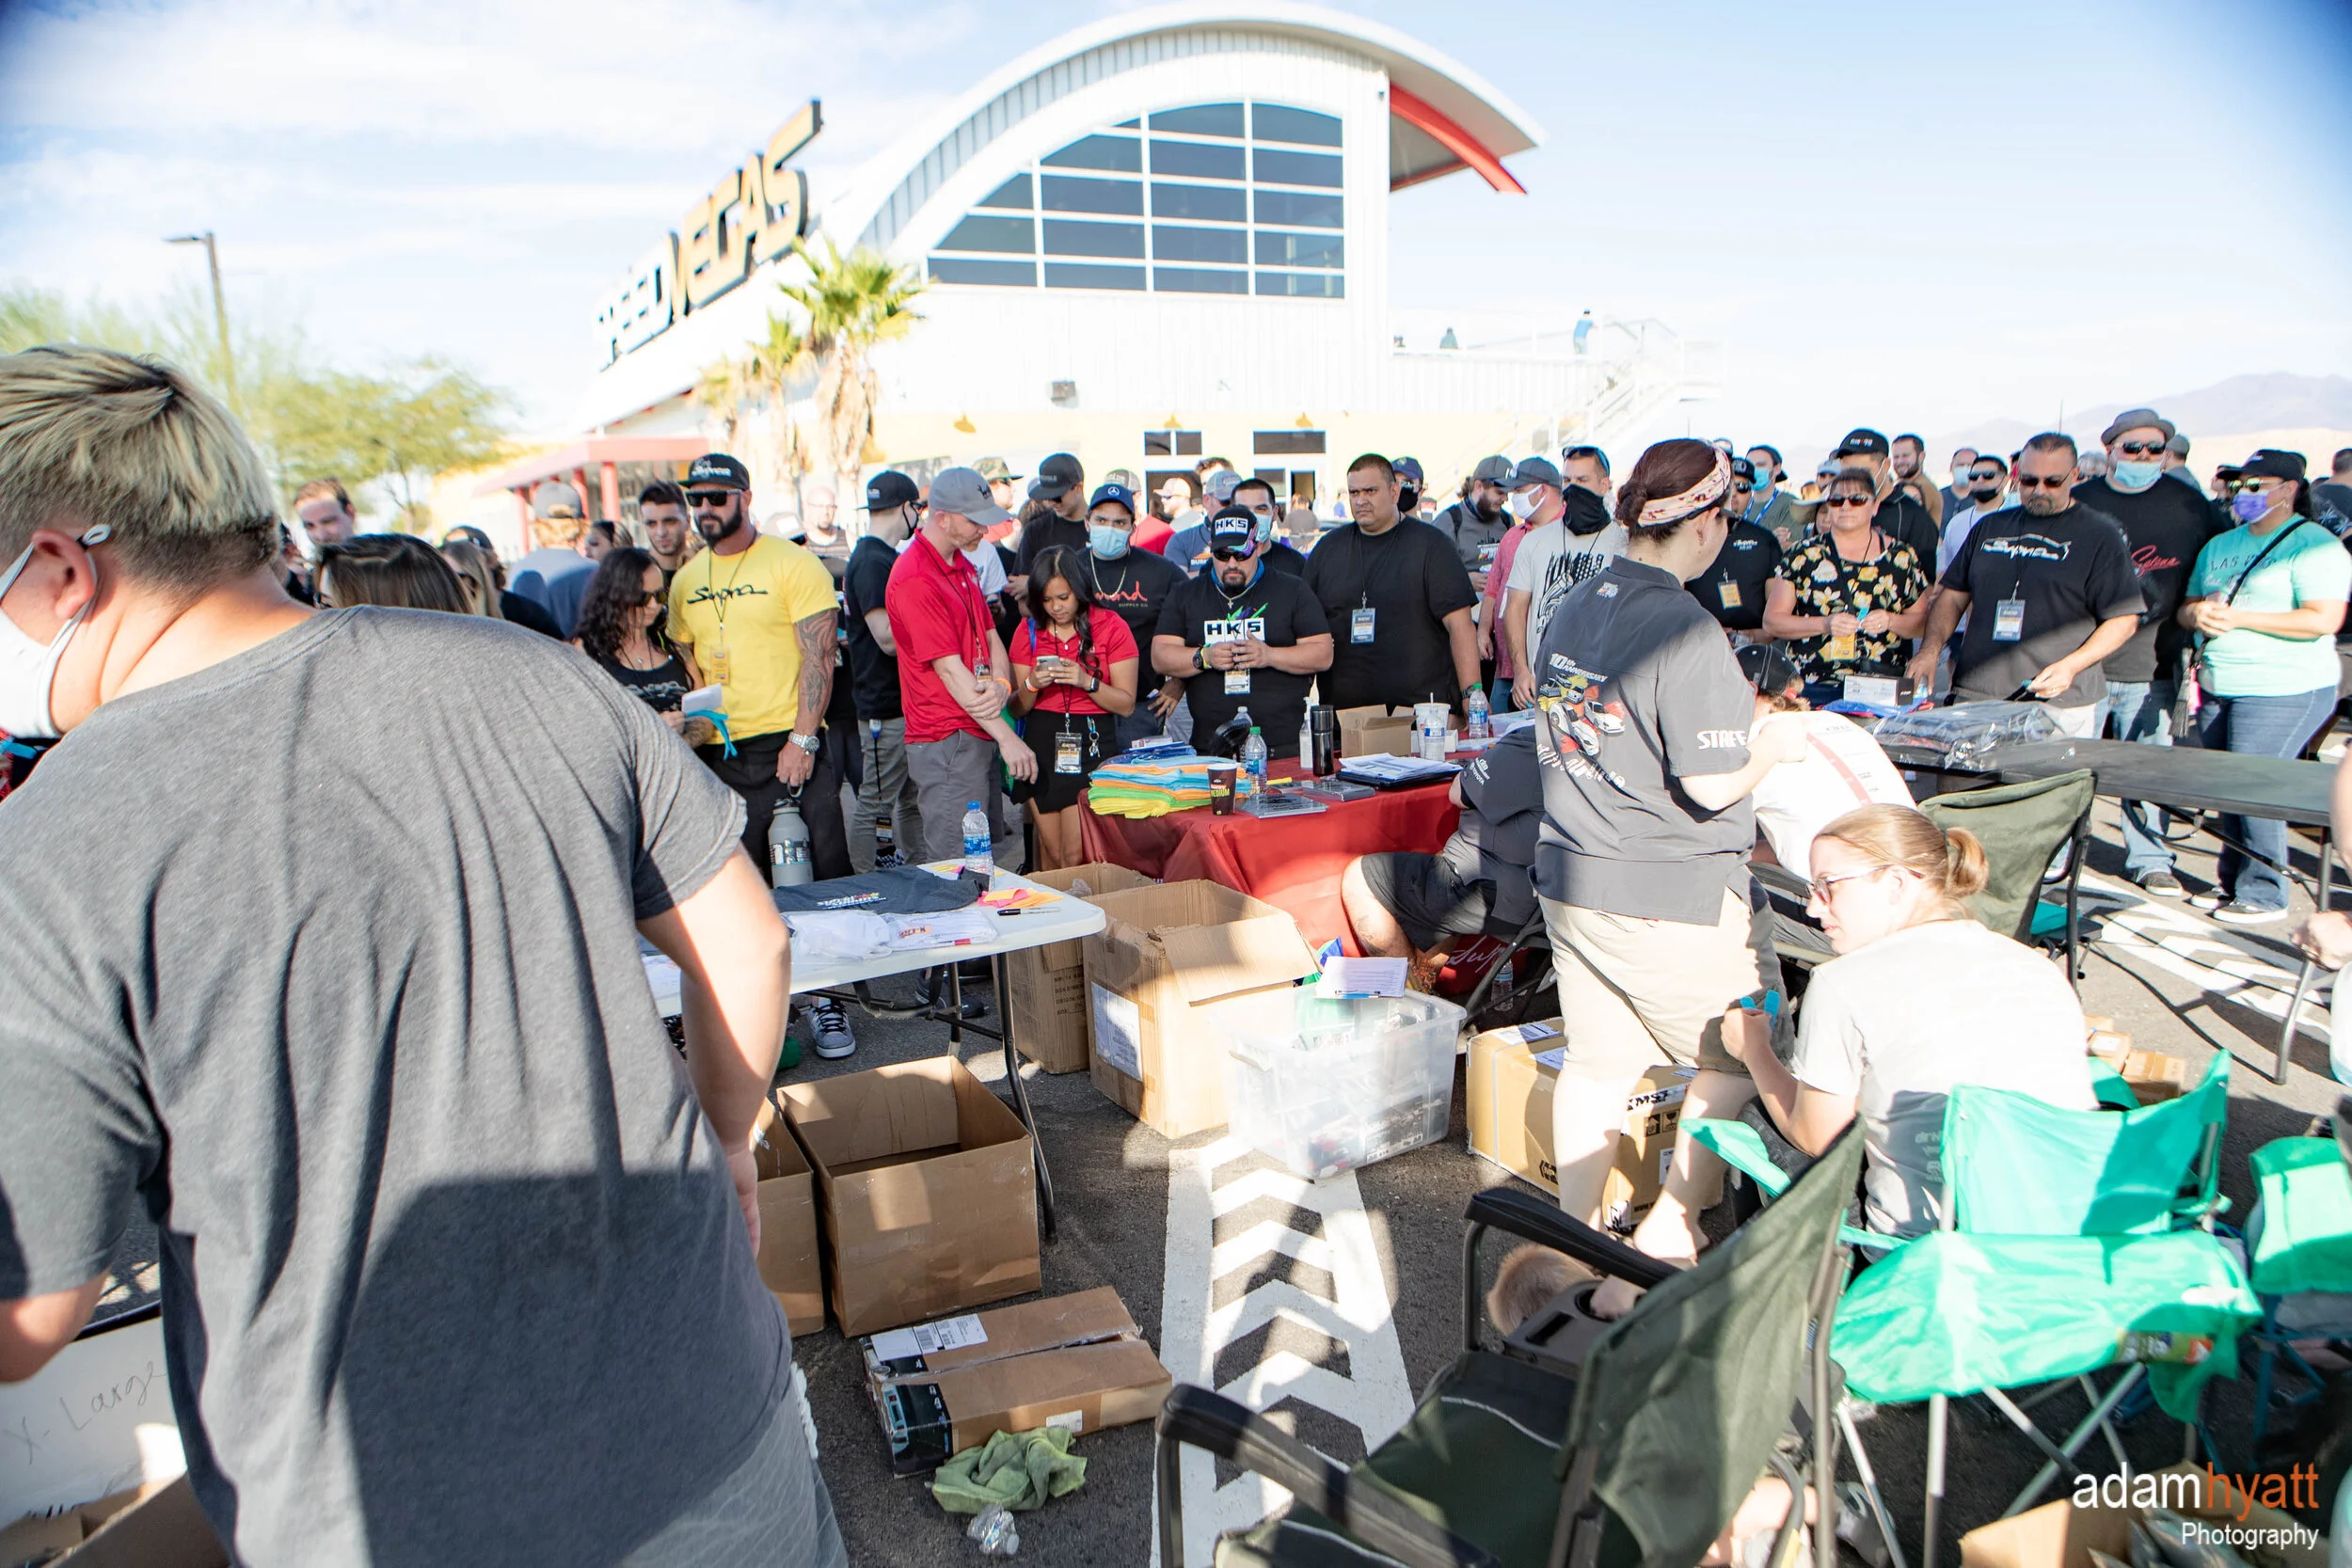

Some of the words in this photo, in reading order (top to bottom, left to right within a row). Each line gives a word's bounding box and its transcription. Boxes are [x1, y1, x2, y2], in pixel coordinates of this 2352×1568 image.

[1216, 518, 1248, 530] HKS
[2211, 553, 2239, 571] LAS
[687, 583, 768, 606] Supra
[1206, 621, 1262, 635] HKS
[1445, 934, 1529, 974] Sup
